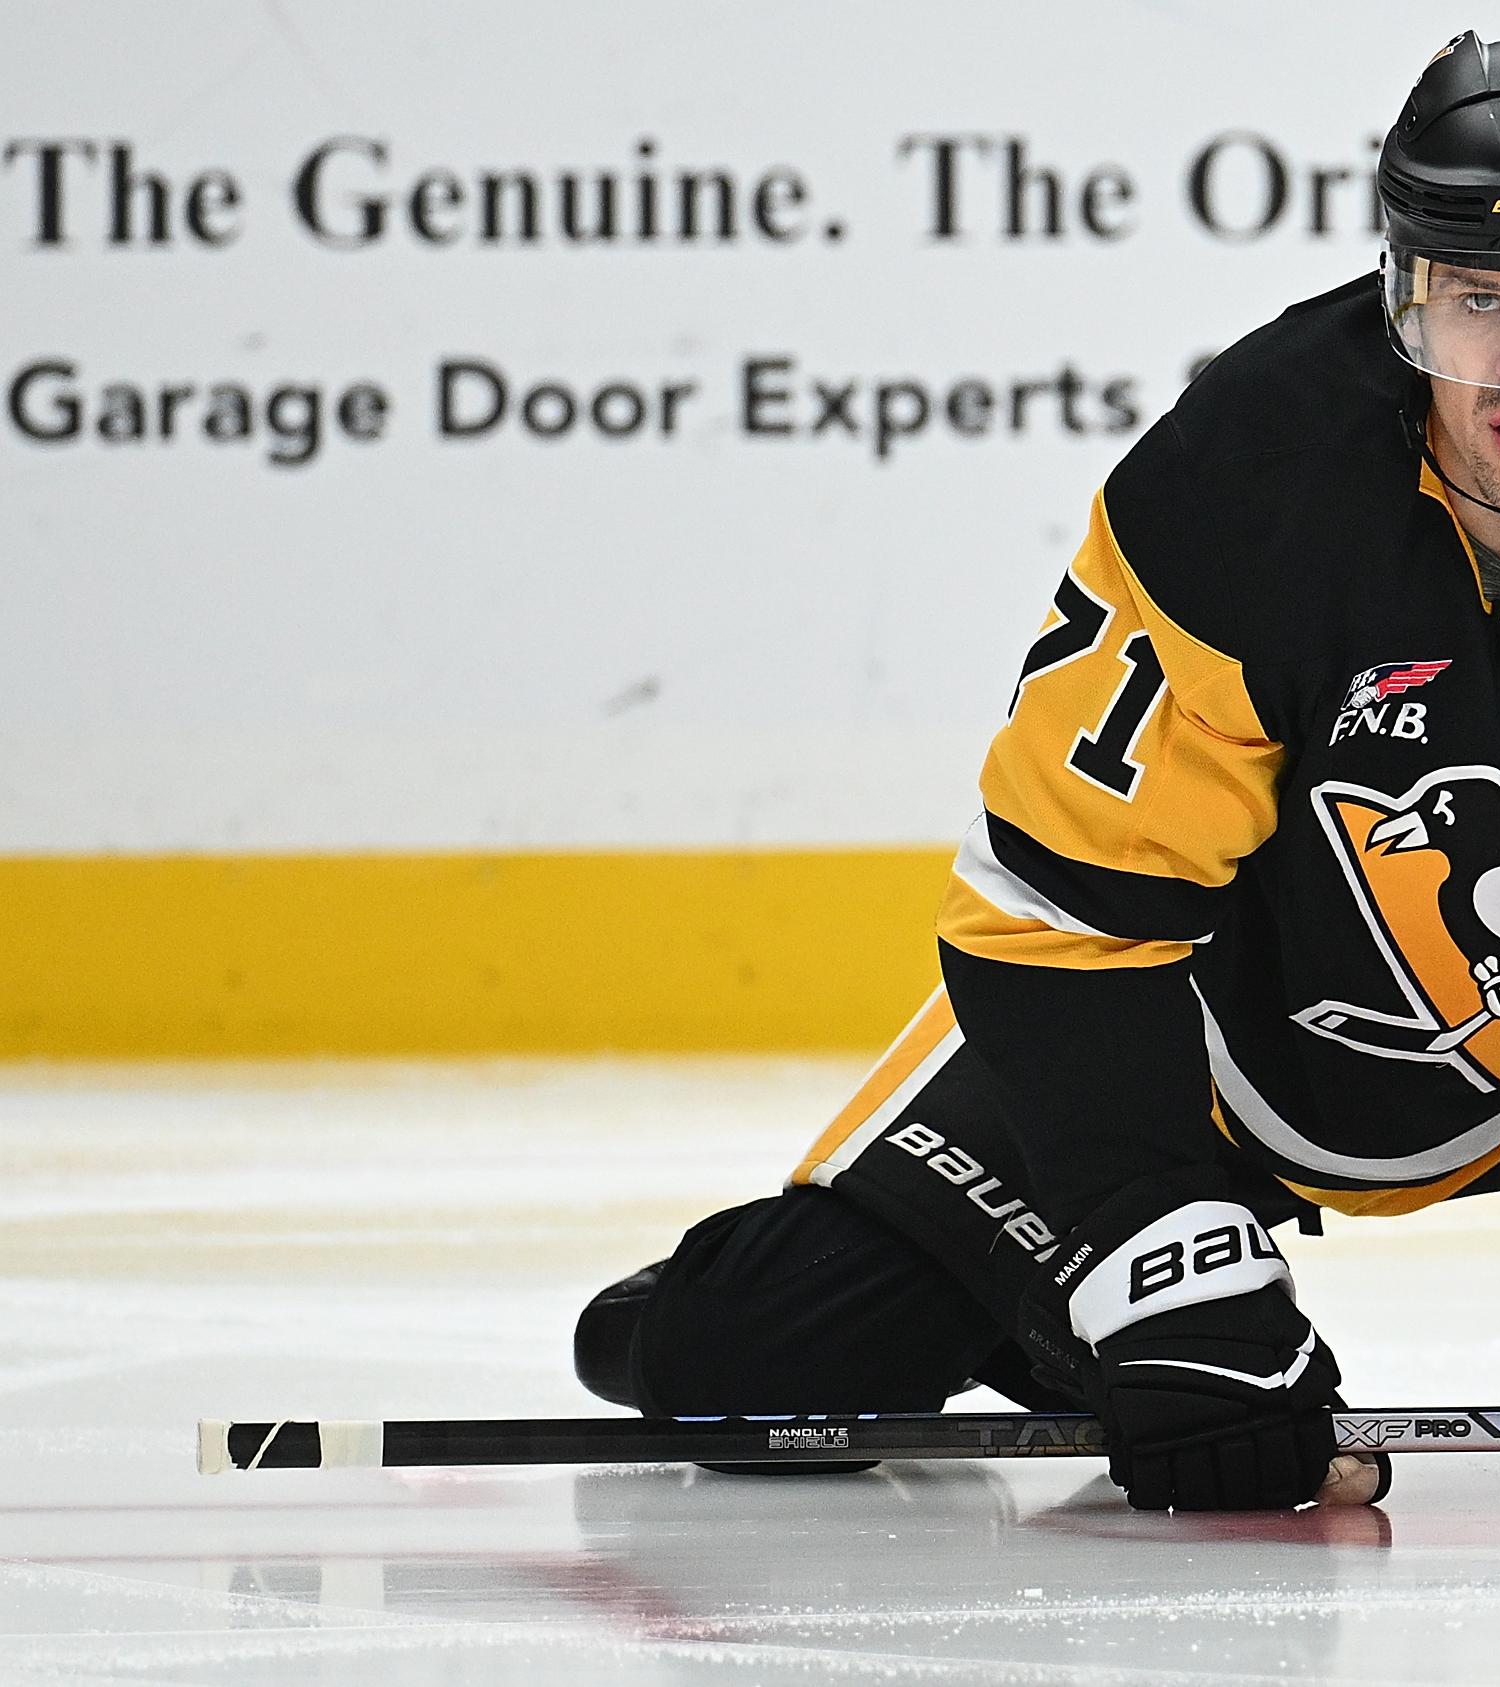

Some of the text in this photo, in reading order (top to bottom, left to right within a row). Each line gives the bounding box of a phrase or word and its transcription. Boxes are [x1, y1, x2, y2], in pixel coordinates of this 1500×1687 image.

[2, 136, 243, 248] The
[289, 134, 845, 248] Genuine.
[897, 134, 1136, 242] The
[4, 352, 1138, 470] Garage Door Experts
[1007, 563, 1169, 804] 71
[1054, 1243, 1094, 1287] MALKIN
[1128, 1222, 1285, 1305] BAU
[768, 1436, 849, 1449] SHIELD
[769, 1427, 849, 1437] NANOLITE
[957, 1419, 1108, 1457] TAC
[1335, 1418, 1472, 1448] XF PRO
